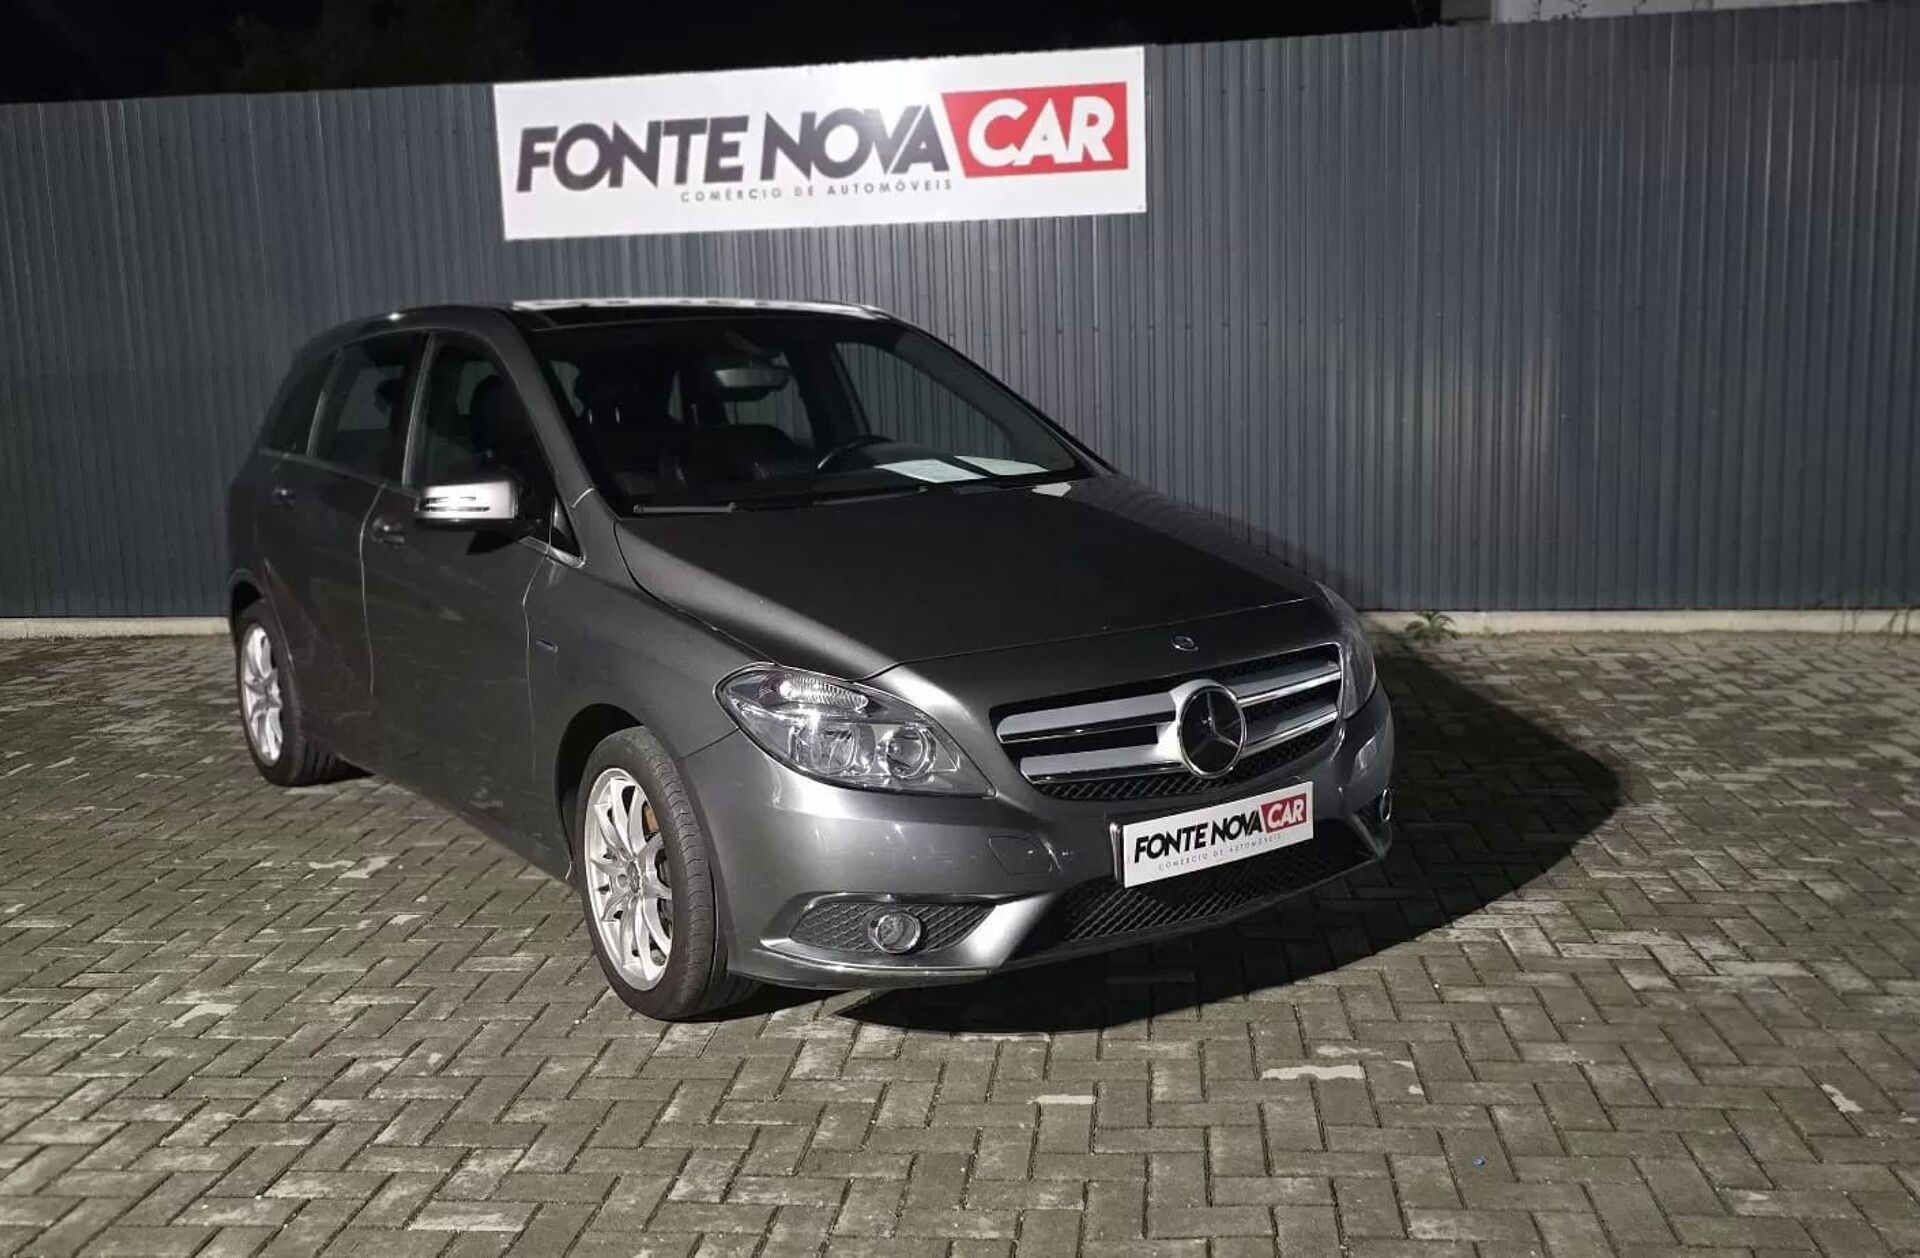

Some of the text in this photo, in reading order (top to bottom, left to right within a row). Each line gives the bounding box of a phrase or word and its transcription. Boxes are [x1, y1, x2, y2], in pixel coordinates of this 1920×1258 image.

[516, 97, 1115, 193] FONTE NOVA CAR
[681, 178, 952, 203] COMÉRCIO DE AUTOMÓVEIS
[1134, 798, 1305, 863] FONTE NOVA CAR
